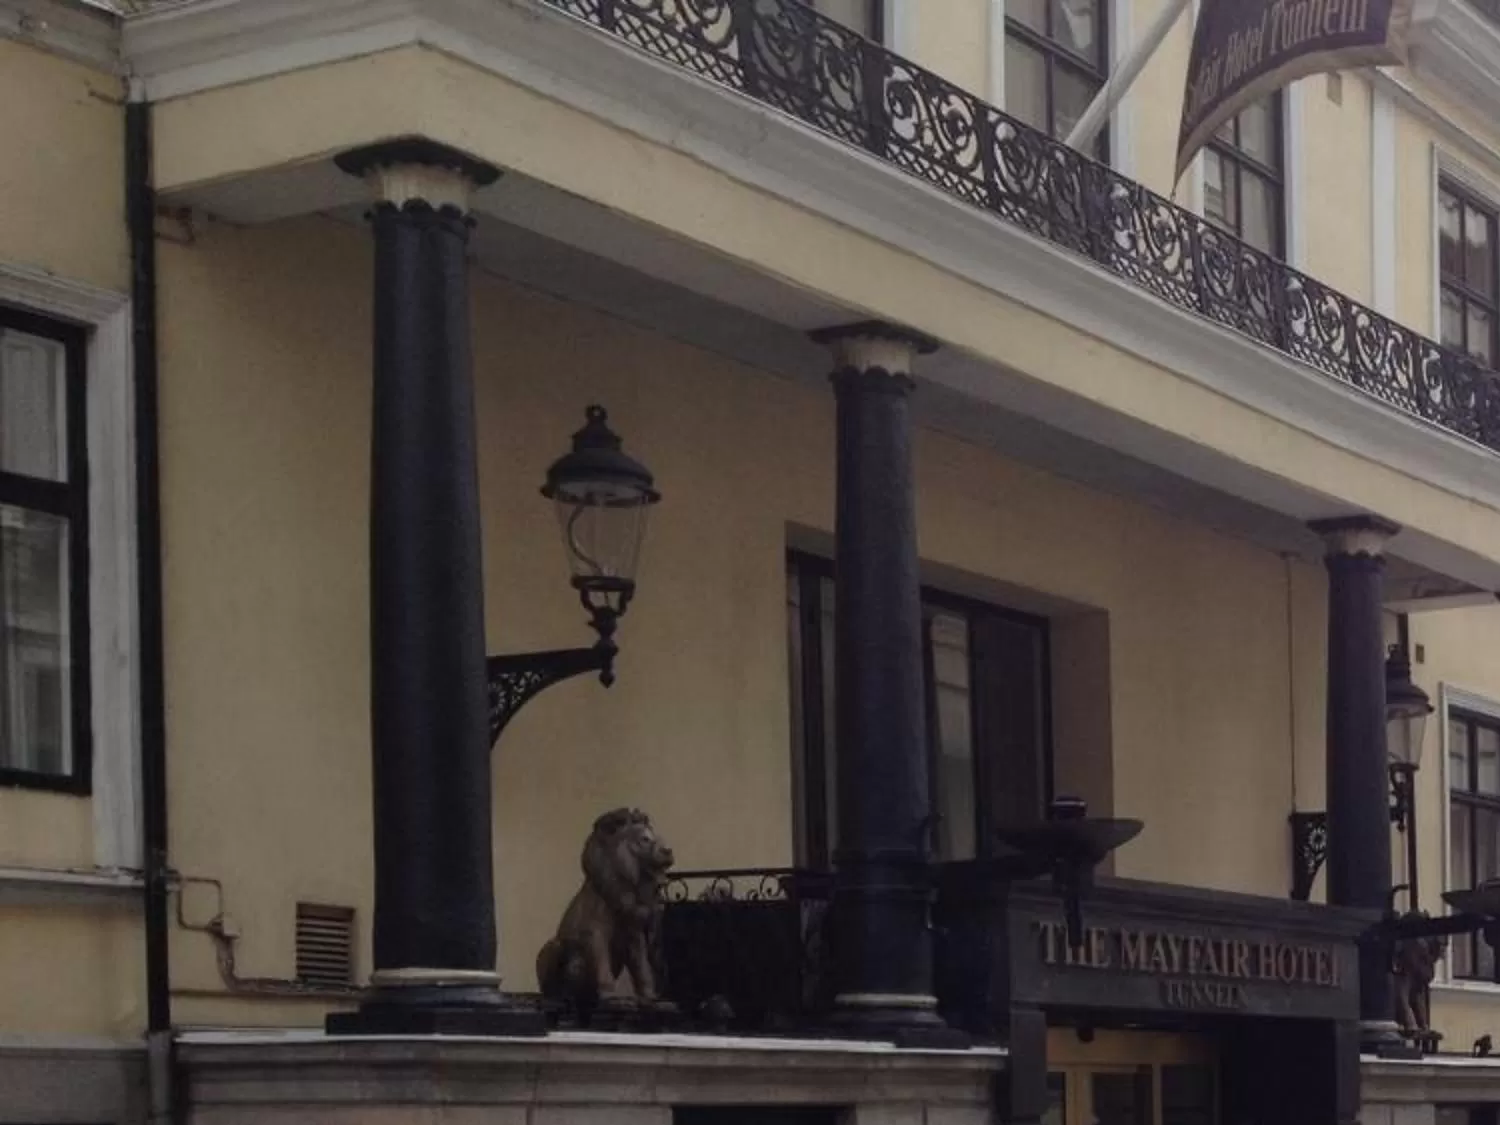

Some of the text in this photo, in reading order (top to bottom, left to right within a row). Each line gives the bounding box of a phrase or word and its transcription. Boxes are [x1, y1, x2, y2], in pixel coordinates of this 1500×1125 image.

[1038, 920, 1342, 987] THE MAYFAIR HOTEL
